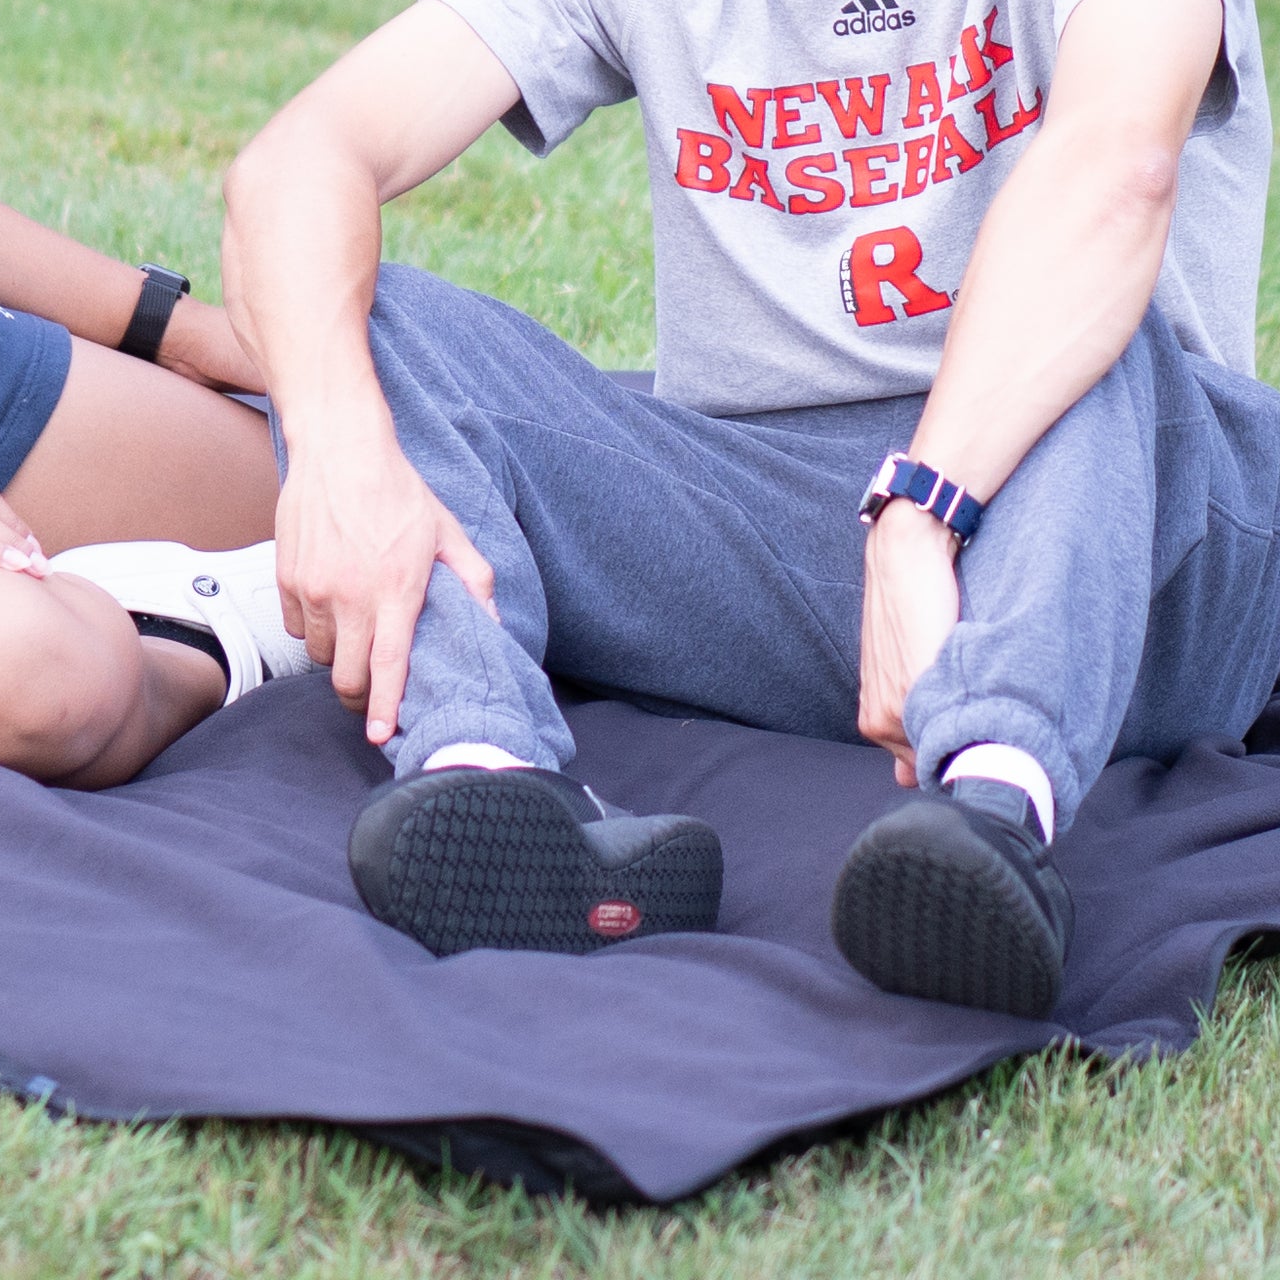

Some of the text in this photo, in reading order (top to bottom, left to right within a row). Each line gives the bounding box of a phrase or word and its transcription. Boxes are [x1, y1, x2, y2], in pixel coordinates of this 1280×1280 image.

[832, 8, 916, 37] adidas
[839, 249, 858, 313] NEWARK
[850, 225, 953, 328] R
